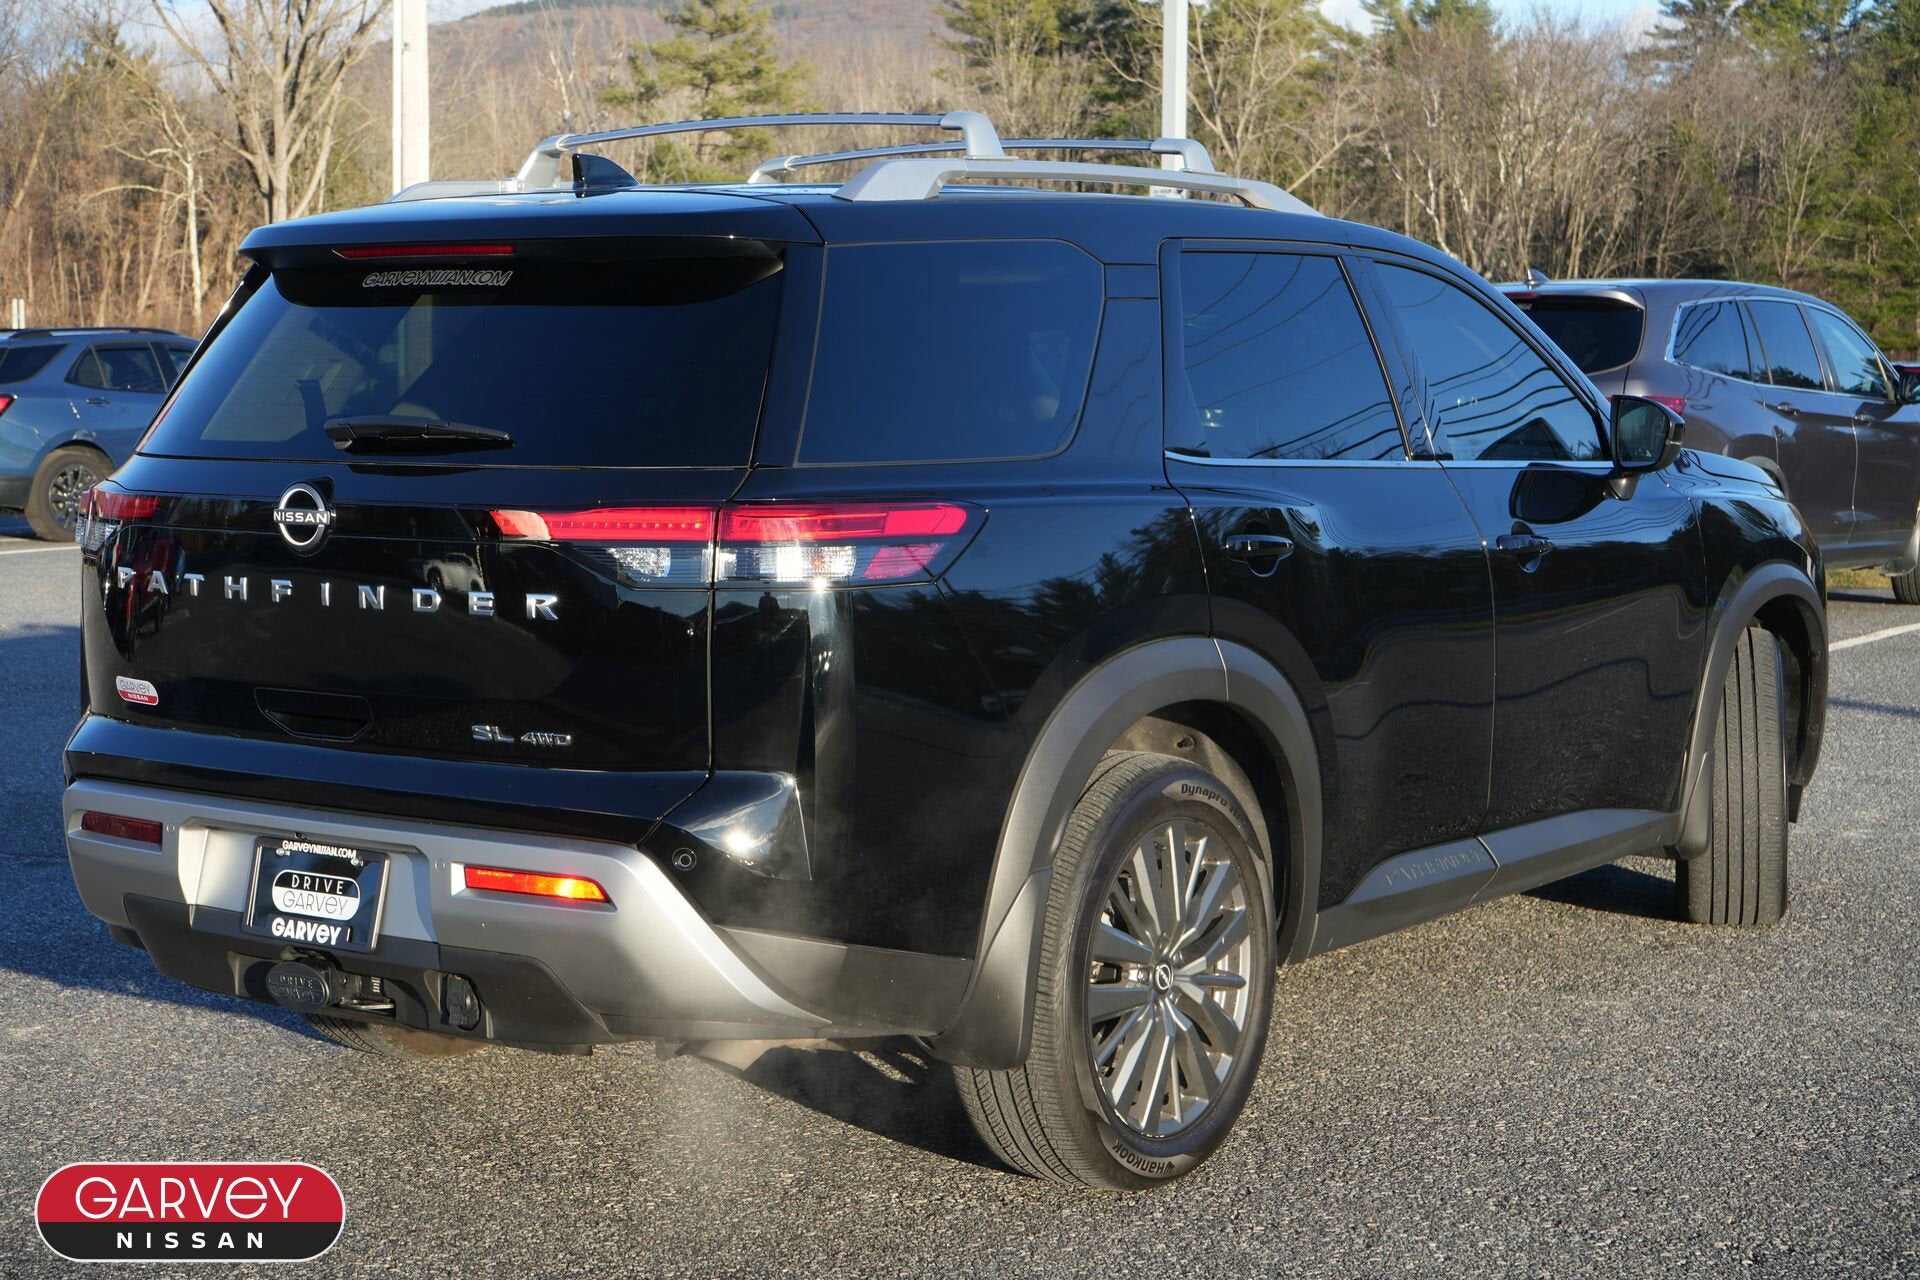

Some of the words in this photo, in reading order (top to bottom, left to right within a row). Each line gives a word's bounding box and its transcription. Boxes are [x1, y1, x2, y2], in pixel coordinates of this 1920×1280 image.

[273, 511, 328, 523] NISSAN
[116, 565, 558, 621] PATHFINDER
[127, 693, 149, 702] NISSAN
[472, 725, 514, 743] SL
[520, 732, 571, 747] 4WD
[1181, 783, 1228, 808] Dynapro
[291, 874, 344, 895] DRIVE
